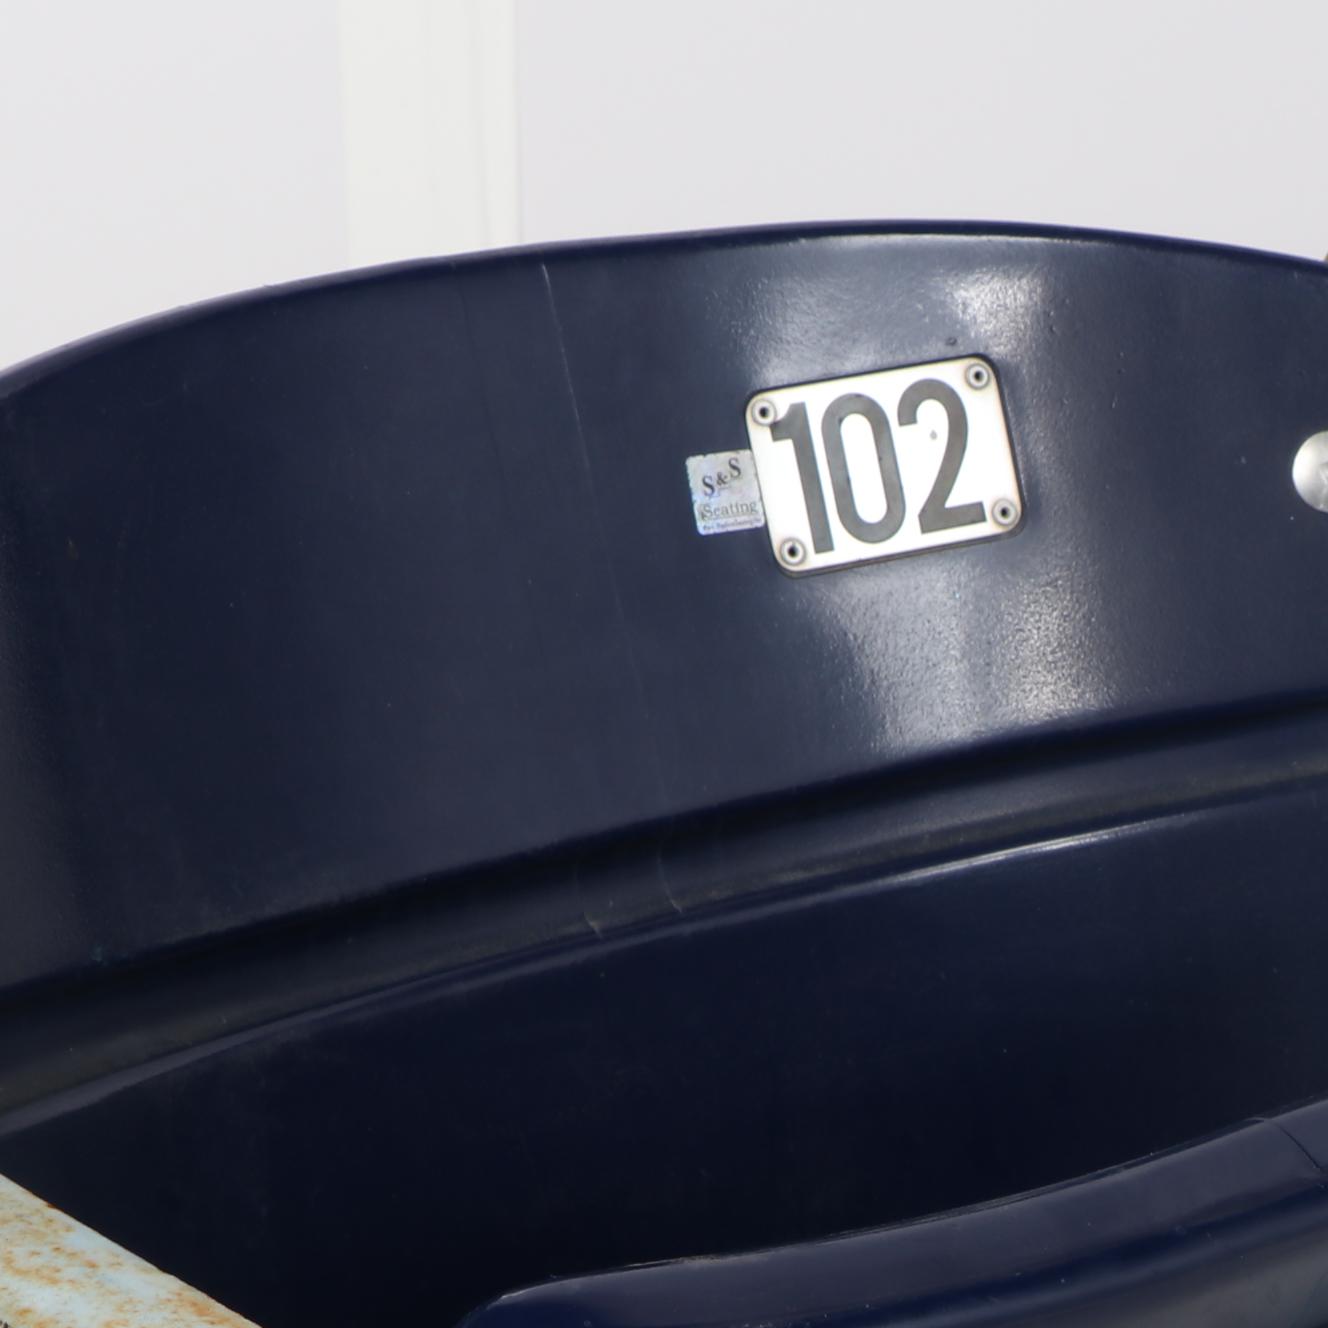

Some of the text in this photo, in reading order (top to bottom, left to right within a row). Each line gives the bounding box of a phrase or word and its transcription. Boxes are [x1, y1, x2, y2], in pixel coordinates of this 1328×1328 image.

[701, 457, 742, 498] S&S
[770, 377, 987, 555] 102
[702, 500, 759, 519] Seating
